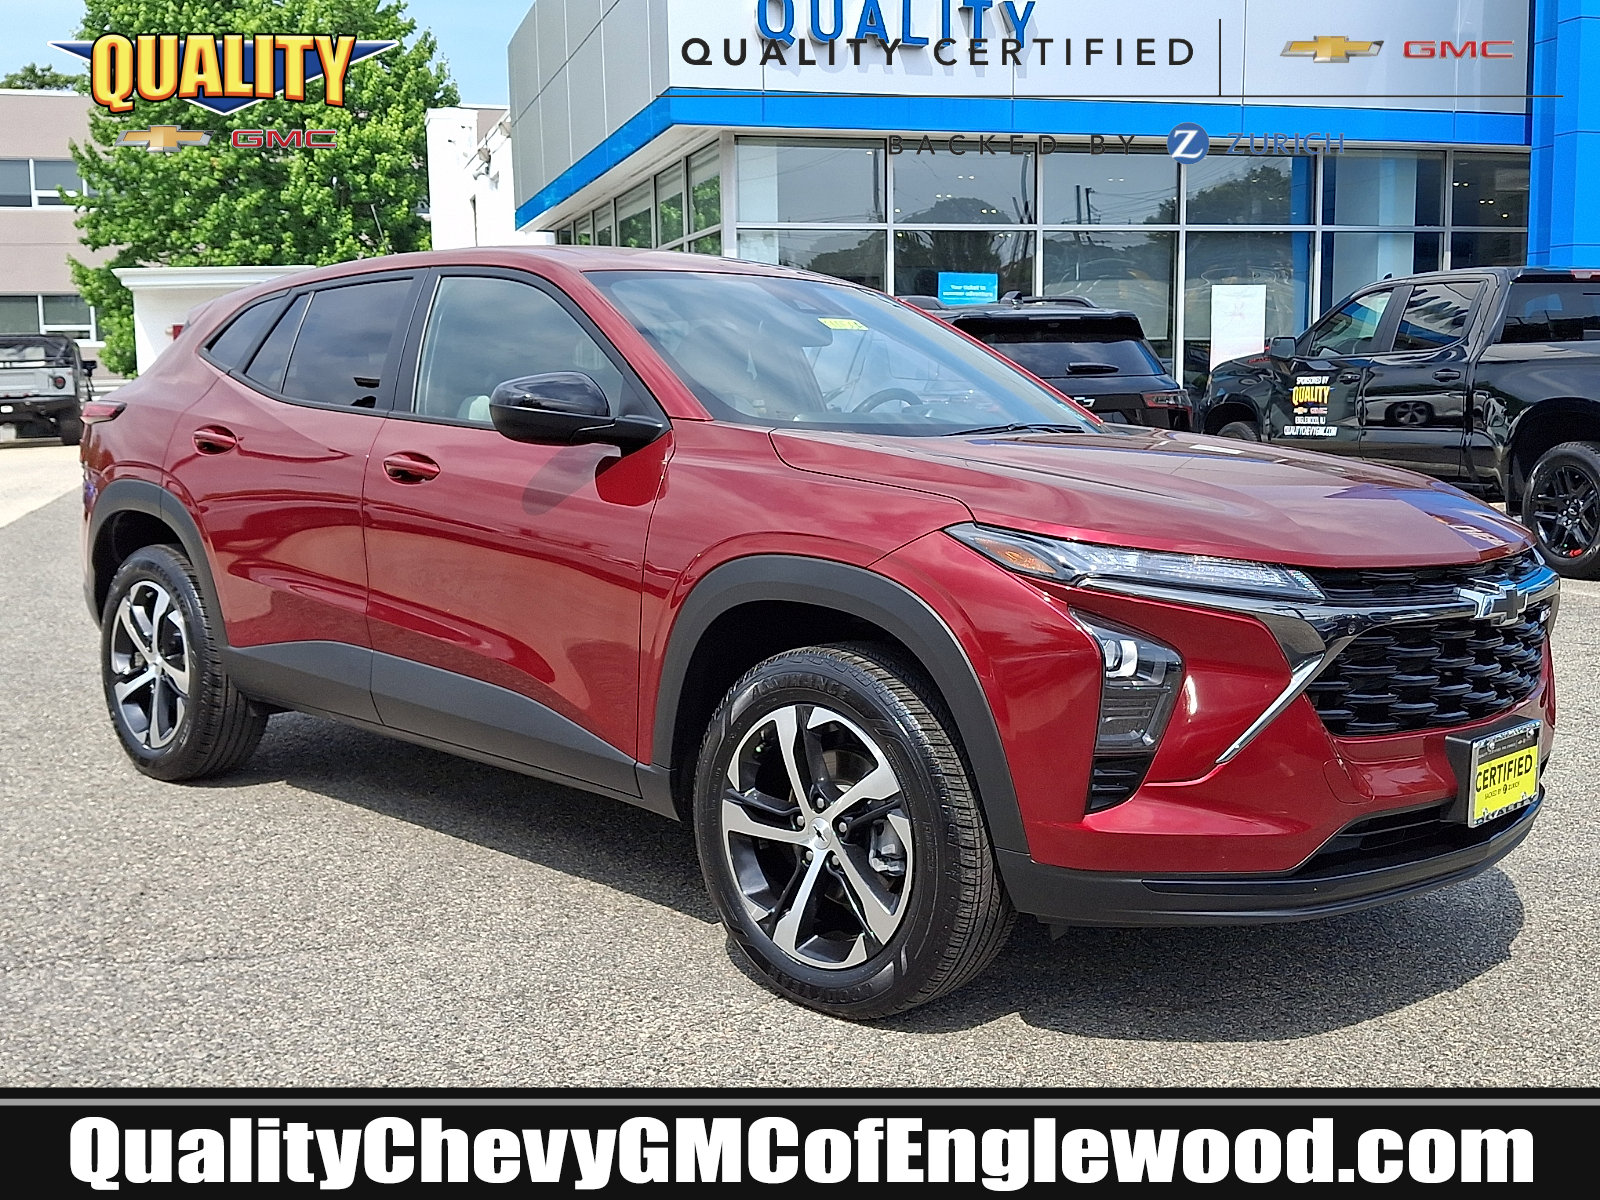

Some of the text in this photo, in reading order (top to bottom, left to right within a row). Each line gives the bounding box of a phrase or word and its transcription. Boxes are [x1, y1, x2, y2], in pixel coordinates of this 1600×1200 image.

[757, 0, 1036, 48] QUALITY
[1292, 386, 1331, 405] QUALITY
[1475, 754, 1533, 792] CERTIFIED
